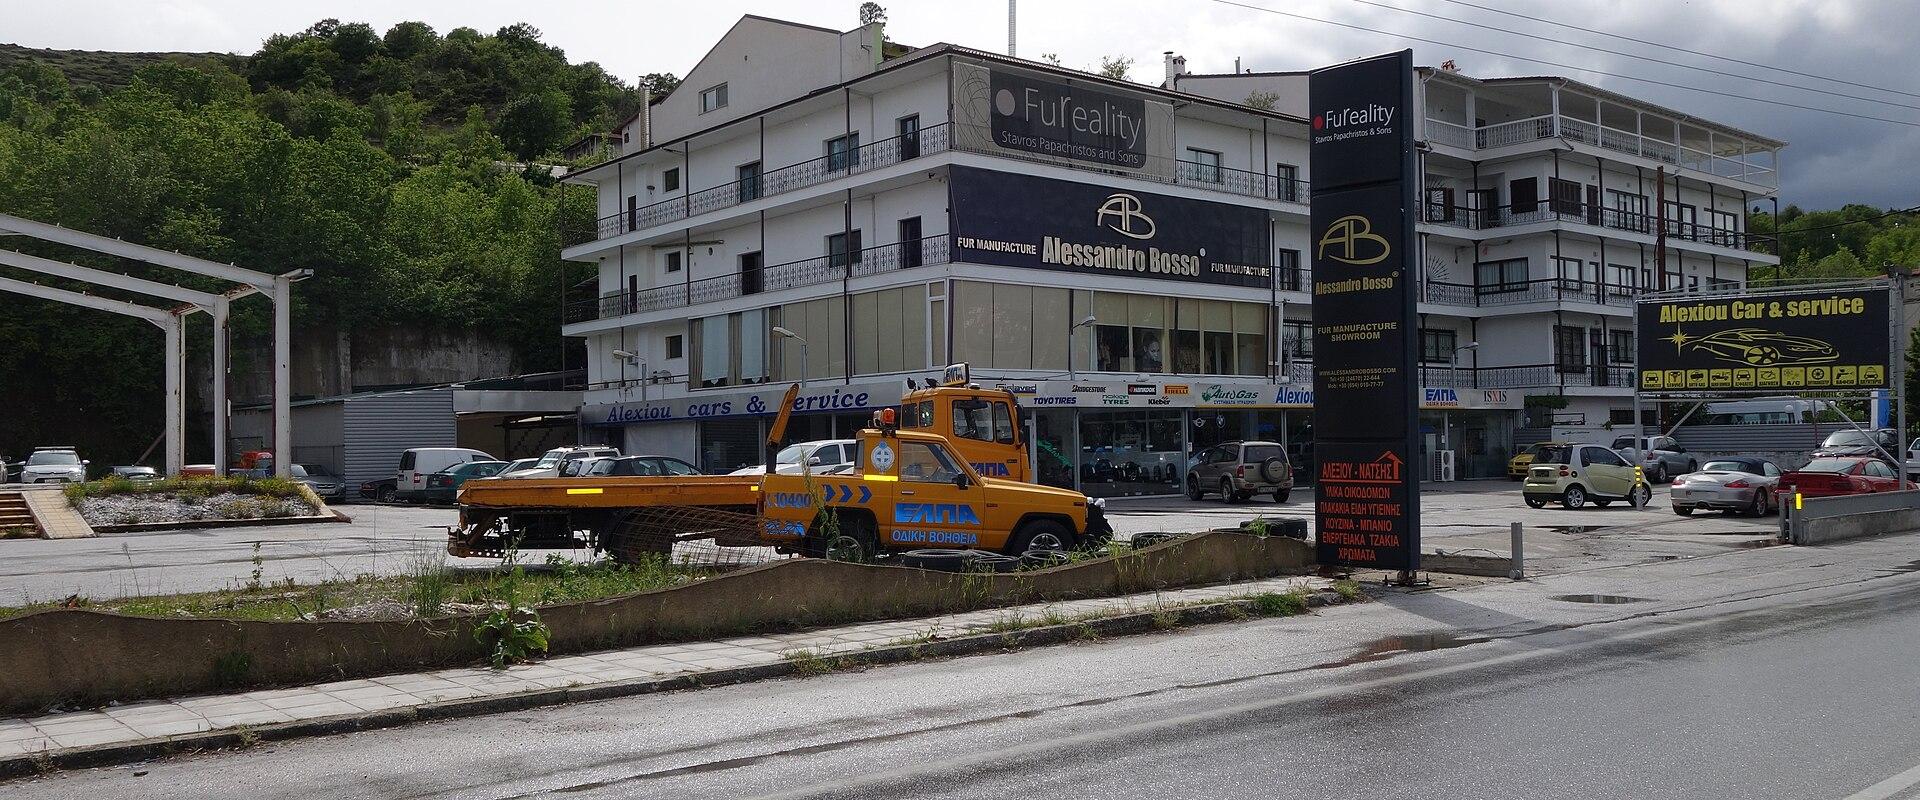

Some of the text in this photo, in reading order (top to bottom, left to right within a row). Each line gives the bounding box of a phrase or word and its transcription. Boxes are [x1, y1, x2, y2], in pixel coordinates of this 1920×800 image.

[1025, 87, 1142, 149] Fureality
[1326, 103, 1395, 129] Fureality
[1315, 127, 1392, 144] Stavros Papachristos & Sons
[1001, 130, 1139, 164] Stavros Papachristos and Sons
[957, 236, 1037, 255] FUR MANUFACTURE
[1042, 235, 1200, 277] Alessandro Bosso
[1211, 262, 1270, 277] FUR MANUFACTURE
[1316, 278, 1361, 295] Alessandro
[1660, 296, 1865, 323] Alexiou Car & service
[1317, 321, 1397, 335] FUR MANUFACTURE
[1331, 331, 1381, 342] SHOWROOM
[1165, 385, 1189, 394] PIRELLI
[606, 388, 869, 422] Alexiou cars & ervice
[969, 462, 1011, 476] ΛΠΑ
[1322, 462, 1353, 479] ΑΛΕΞΙΟΥ
[1359, 463, 1393, 480] ΝΑΤΣΗΣ
[1344, 486, 1391, 499] ΟΙΚΟΔΟΜΩΝ
[1350, 502, 1367, 515] ΕΙΔΗ
[1367, 503, 1401, 516] ΥΓΙΕΙΝΗΣ
[1325, 517, 1355, 530] ΚΟΥΖΙΝΑ
[1360, 519, 1393, 532] ΜΠΑΝΙΟ
[892, 530, 978, 545] ΟΔΙΚΗ ΒΟΗΘΕΙΑ
[1322, 531, 1400, 547] ΕΝΕΡΓΕΙΑΚΑ ΤΖΑΚΙΑ
[1338, 547, 1377, 561] ΧΡΩΜΑΤΑ
